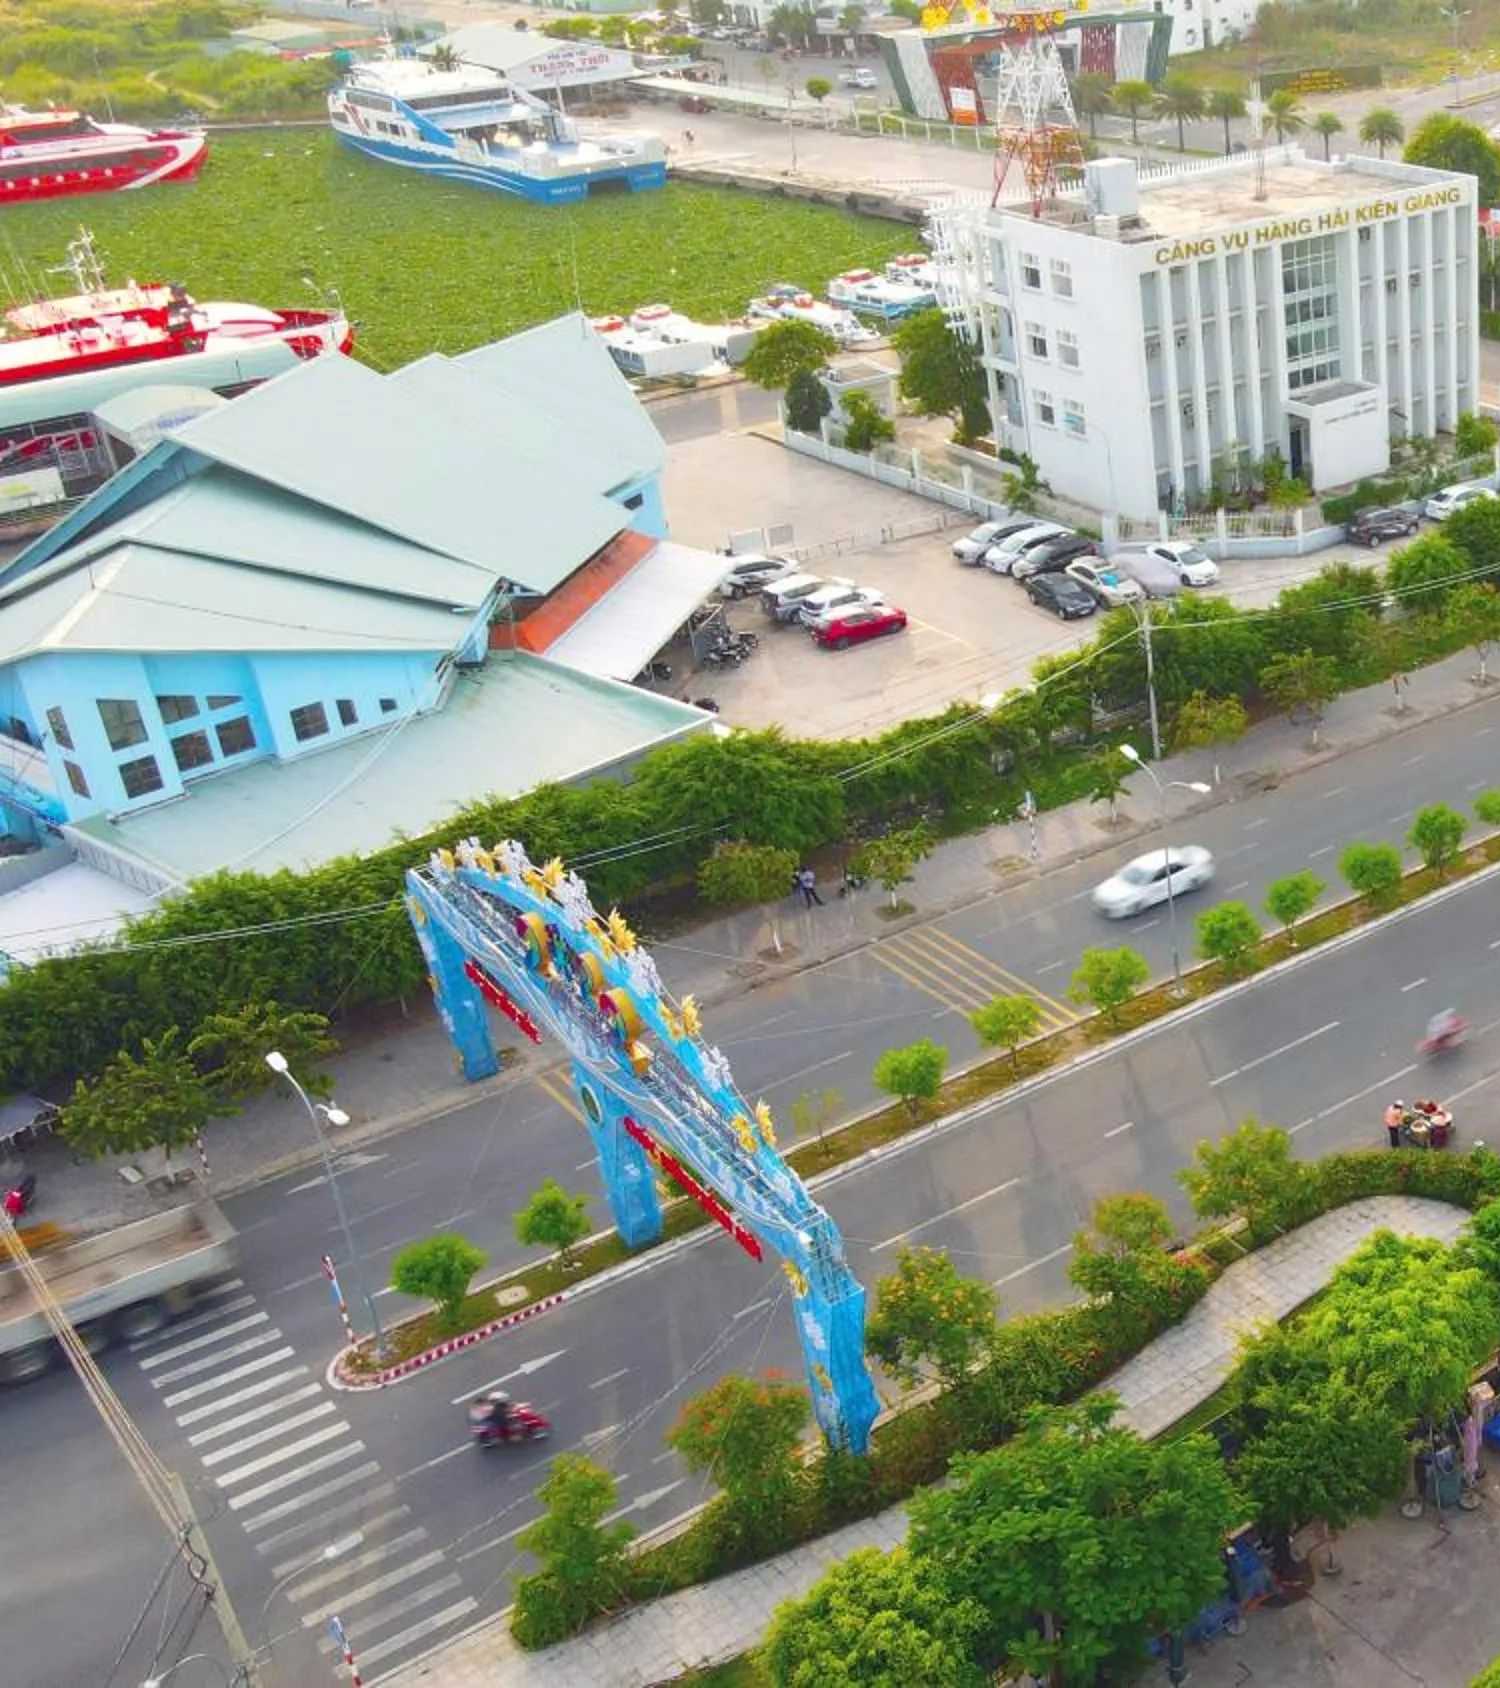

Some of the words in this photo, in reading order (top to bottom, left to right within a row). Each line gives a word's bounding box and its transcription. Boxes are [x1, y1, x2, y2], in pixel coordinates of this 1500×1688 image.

[1154, 237, 1216, 266] CẢNG
[1255, 219, 1313, 244] HÀNG
[1355, 200, 1399, 224] KIÊN
[1403, 187, 1461, 213] GIANG
